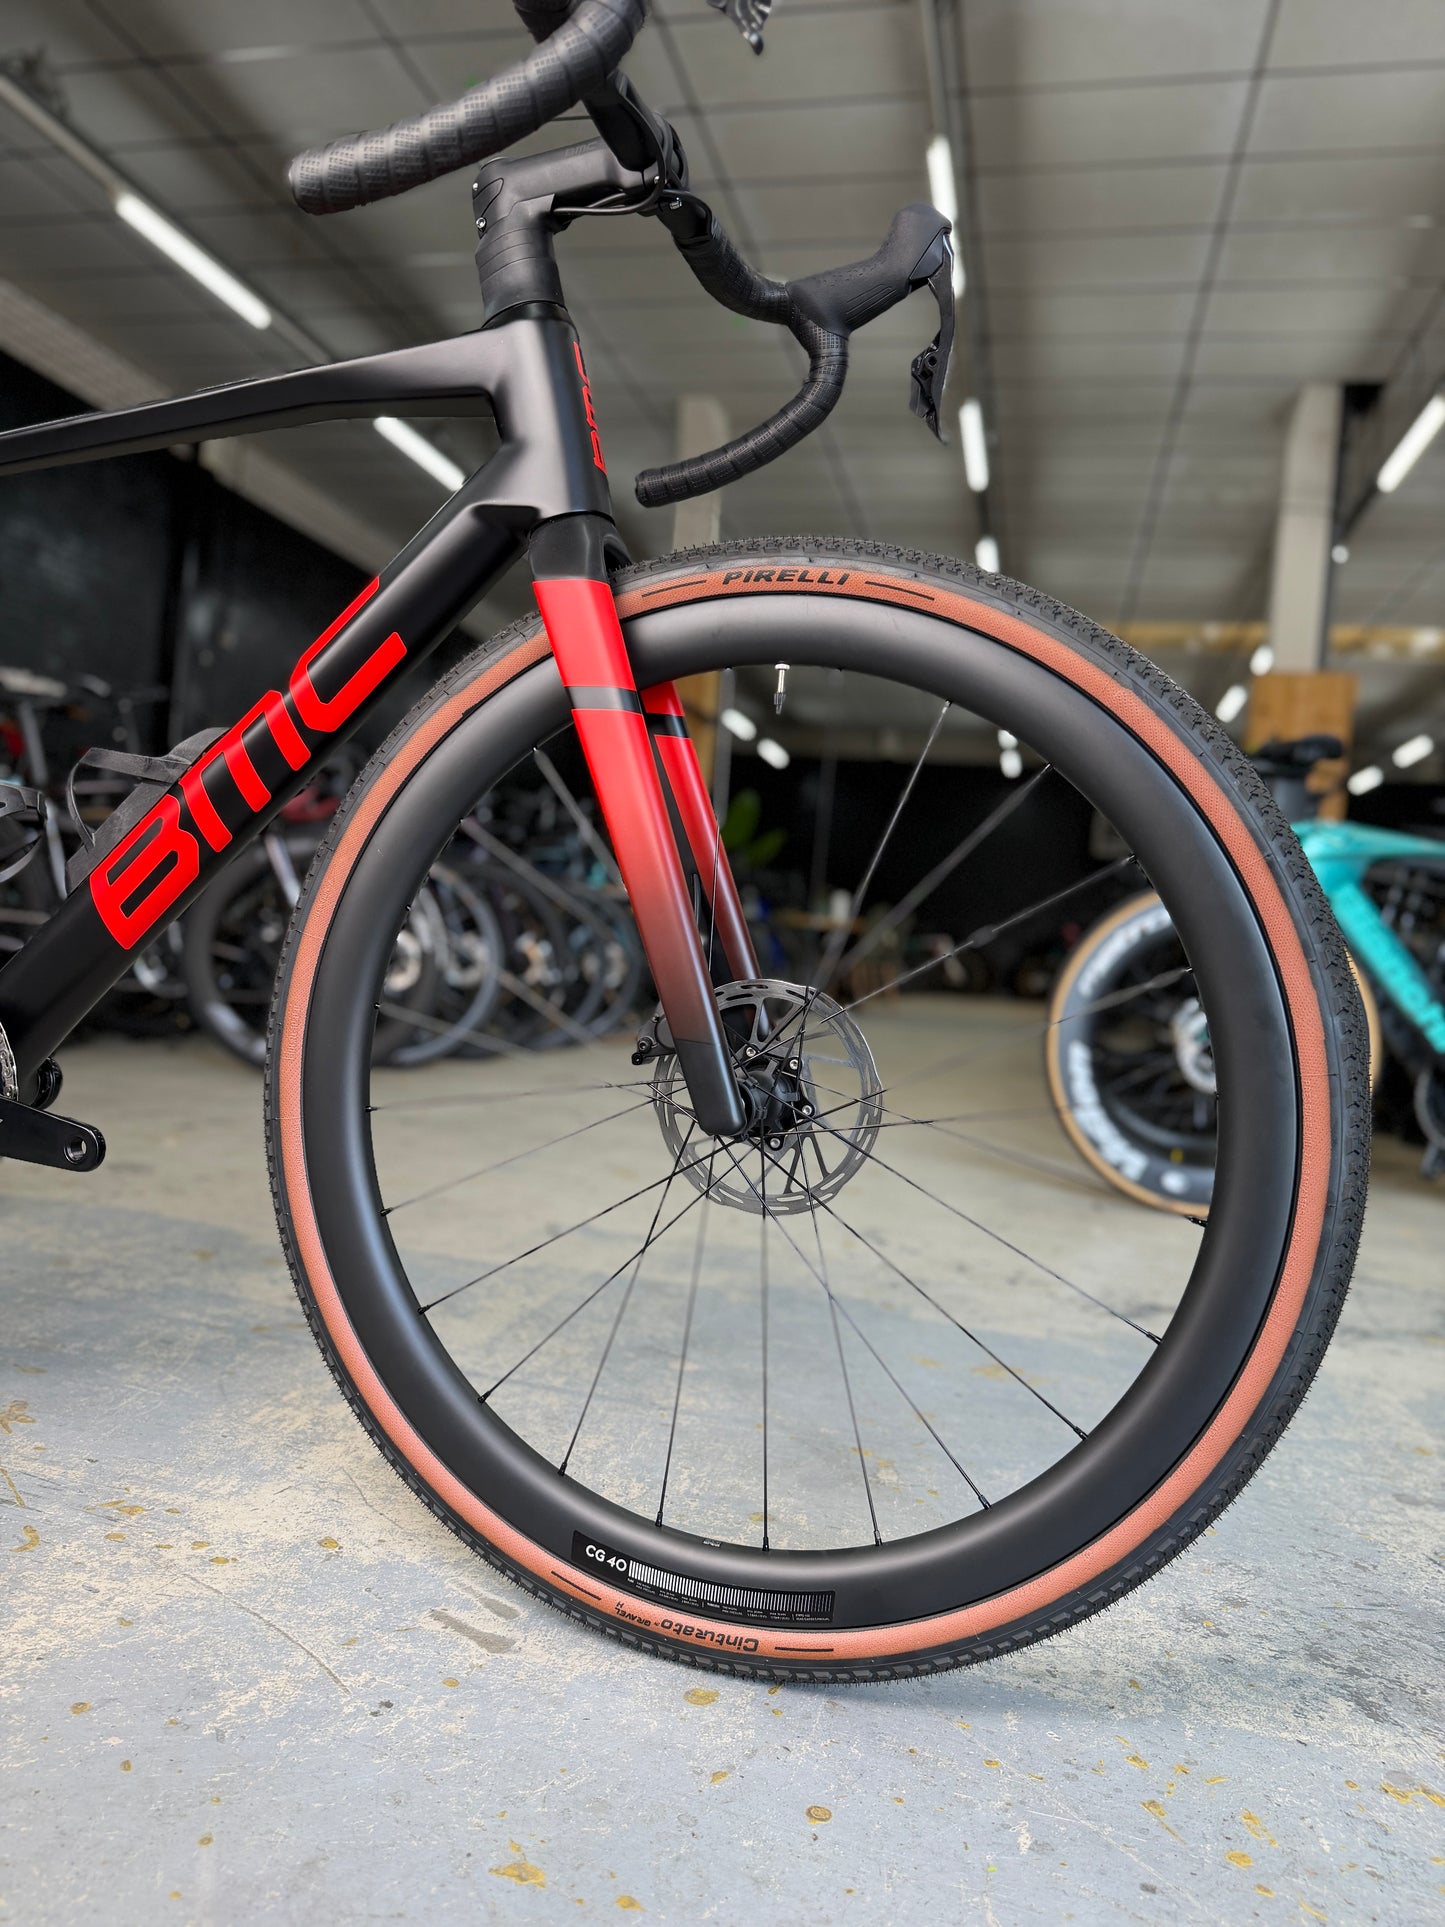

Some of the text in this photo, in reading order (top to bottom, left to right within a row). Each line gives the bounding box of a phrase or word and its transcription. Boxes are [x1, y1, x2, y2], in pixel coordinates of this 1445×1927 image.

[722, 568, 850, 586] PIRELLI
[585, 1544, 628, 1573] CG 40
[614, 1606, 651, 1625] GRAVEL
